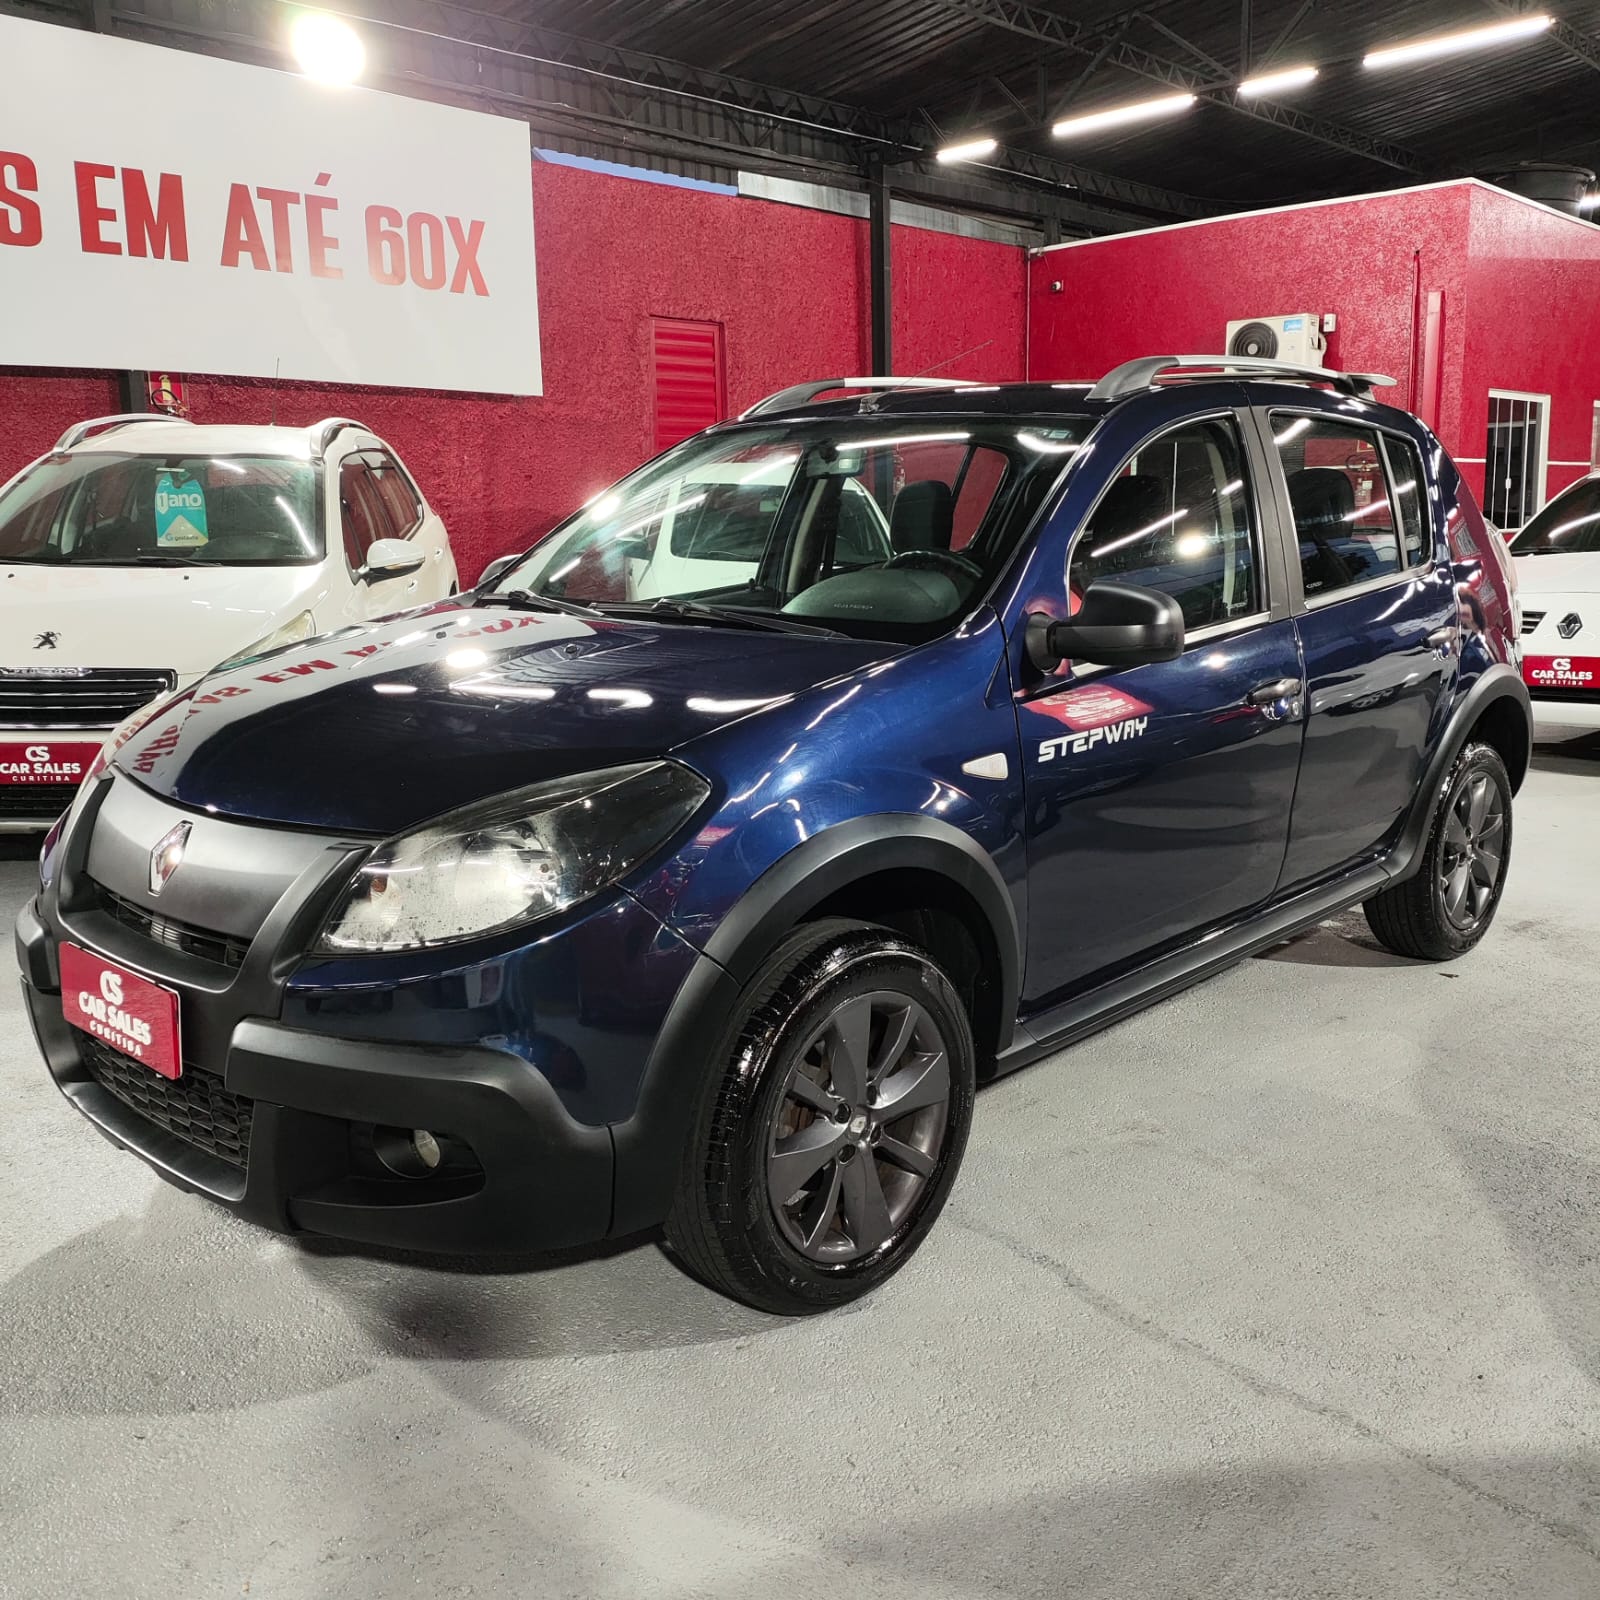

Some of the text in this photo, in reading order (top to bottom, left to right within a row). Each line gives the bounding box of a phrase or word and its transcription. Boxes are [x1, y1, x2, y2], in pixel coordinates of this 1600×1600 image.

[74, 160, 189, 263] EM
[220, 173, 344, 280] ATÉ
[364, 205, 490, 297] 60X
[169, 493, 202, 507] ano
[1531, 669, 1593, 680] CAR SALES
[1552, 658, 1571, 671] CS
[1037, 715, 1148, 763] STEPWAY
[25, 746, 50, 762] CS
[0, 763, 81, 774] CAR SALES
[100, 970, 124, 1006] CS
[78, 991, 152, 1046] CAR SALES
[89, 1020, 142, 1056] CURITIBA
